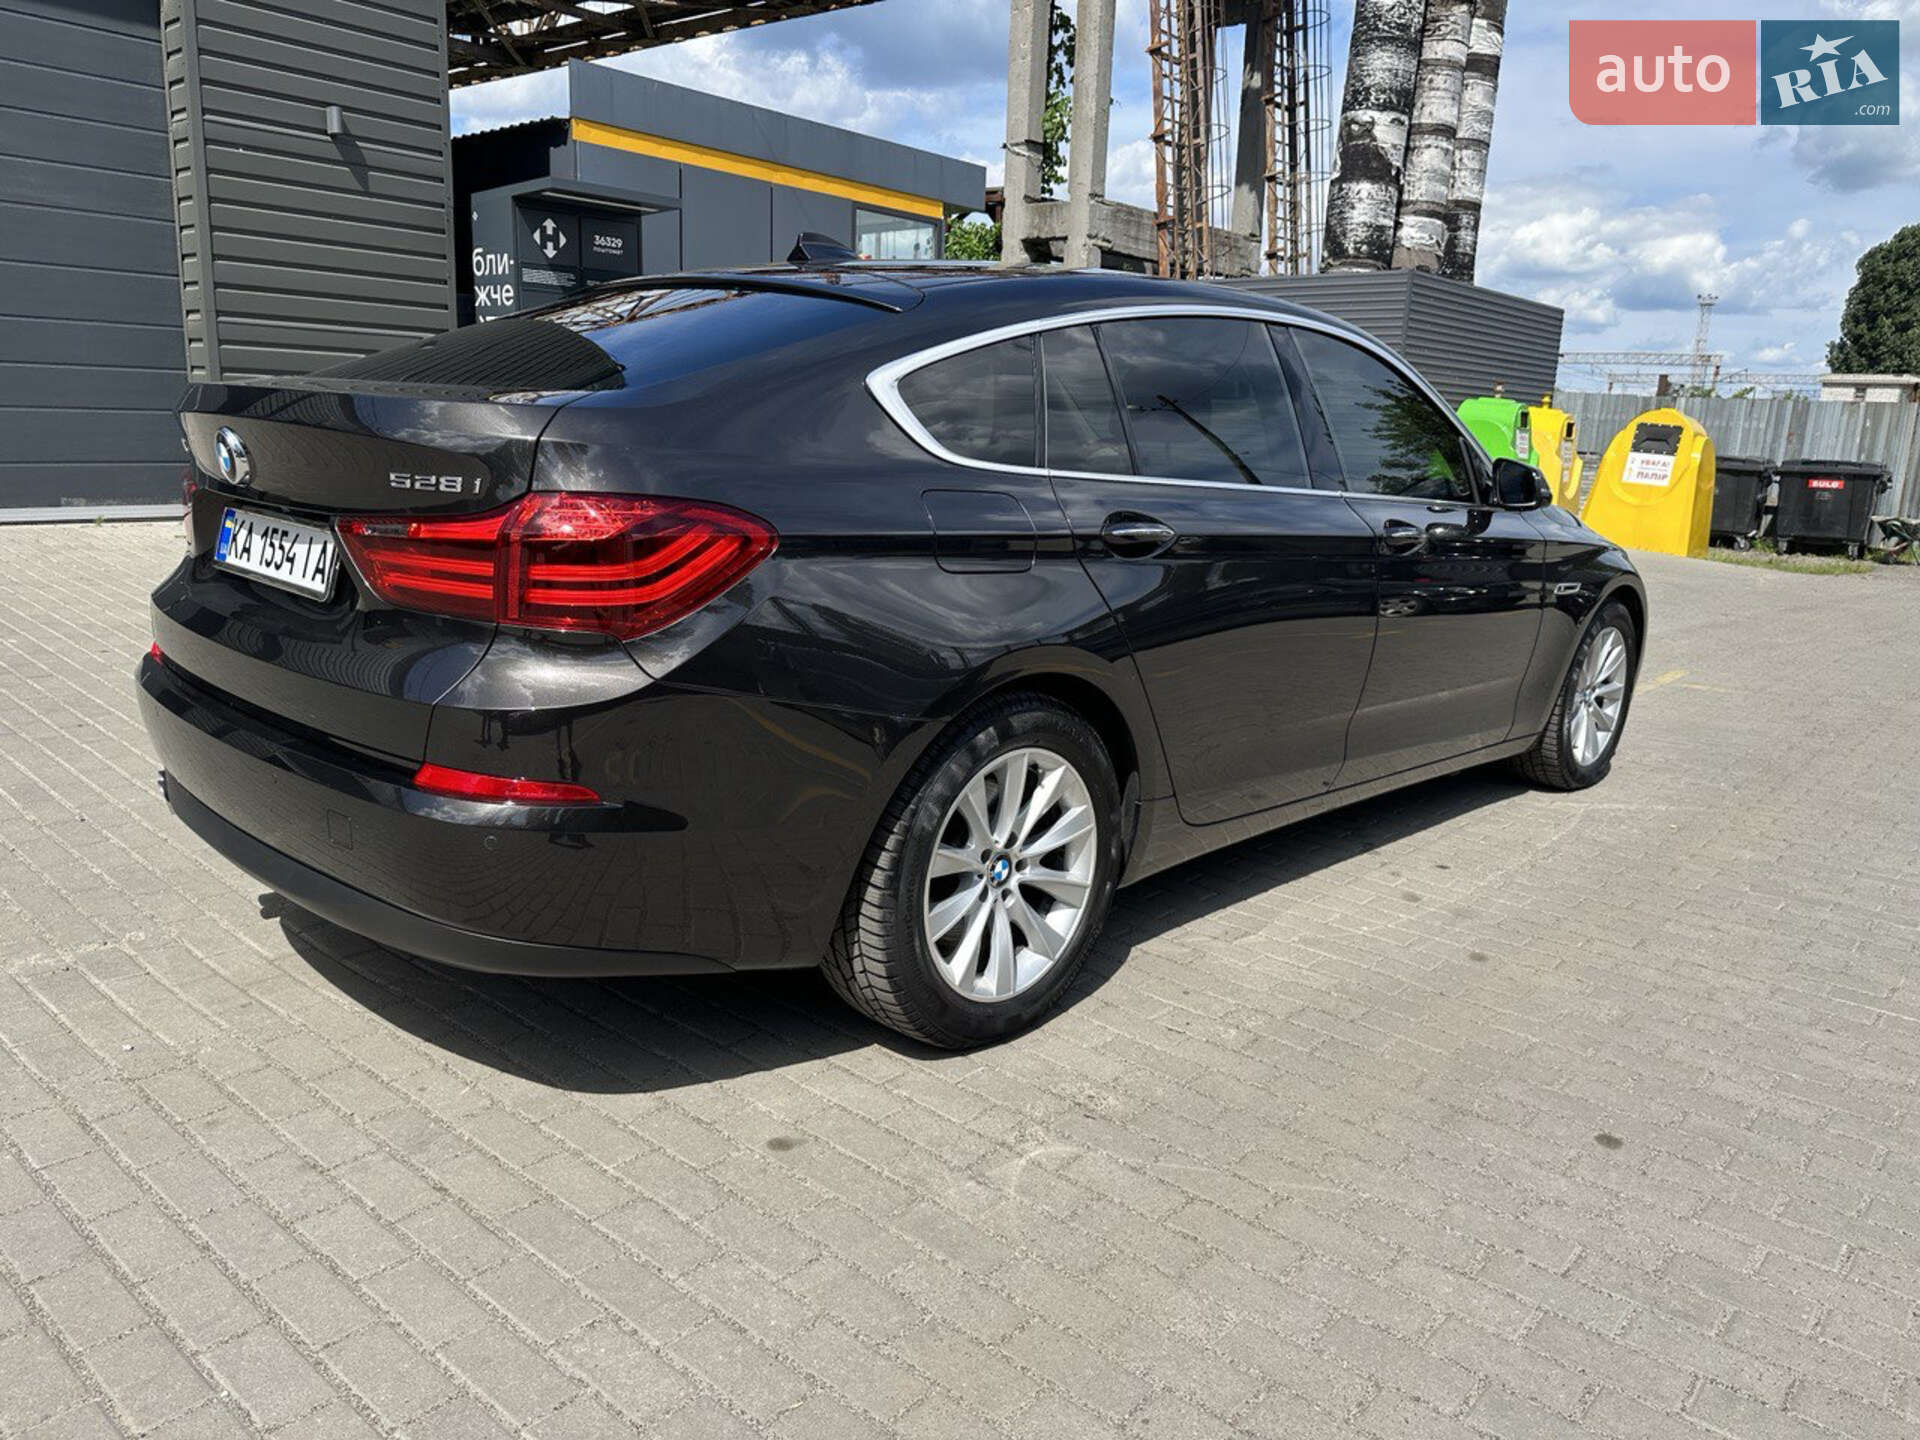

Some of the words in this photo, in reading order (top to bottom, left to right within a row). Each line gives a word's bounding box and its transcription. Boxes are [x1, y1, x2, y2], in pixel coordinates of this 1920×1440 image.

[474, 284, 514, 307] жче
[389, 472, 462, 493] 528
[472, 478, 482, 494] i
[228, 518, 253, 562] KA
[260, 526, 300, 576] 1554
[302, 536, 328, 584] IA
